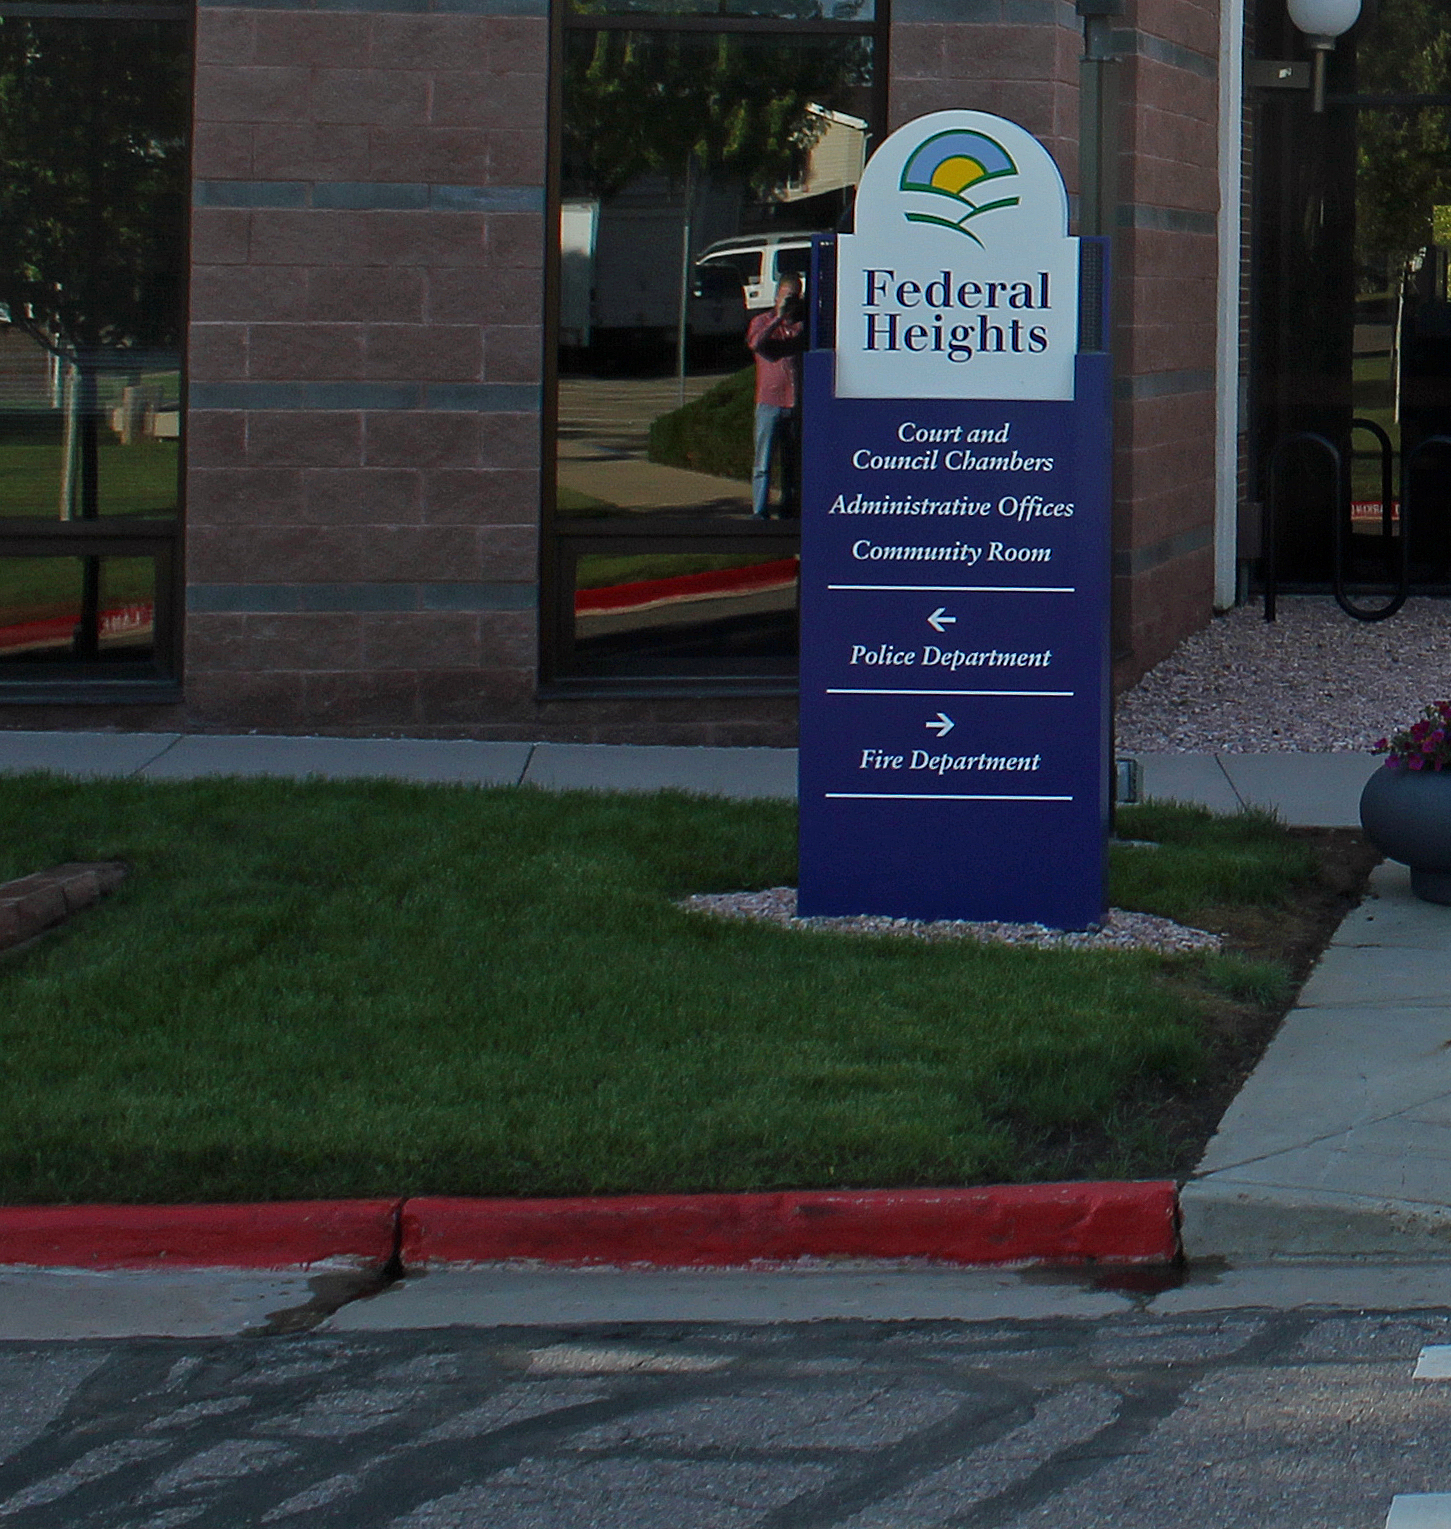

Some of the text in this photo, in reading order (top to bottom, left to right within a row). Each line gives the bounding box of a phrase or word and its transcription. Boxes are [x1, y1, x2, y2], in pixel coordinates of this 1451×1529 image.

[861, 269, 1052, 310] Federal
[862, 313, 1049, 363] Heights
[898, 422, 1010, 443] Court and
[852, 449, 1055, 472] Council Chambers
[829, 493, 1075, 522] Administrative Offices
[852, 540, 1053, 566] Community Room
[850, 644, 1052, 671] Police Department
[860, 749, 1042, 775] Fire Department
